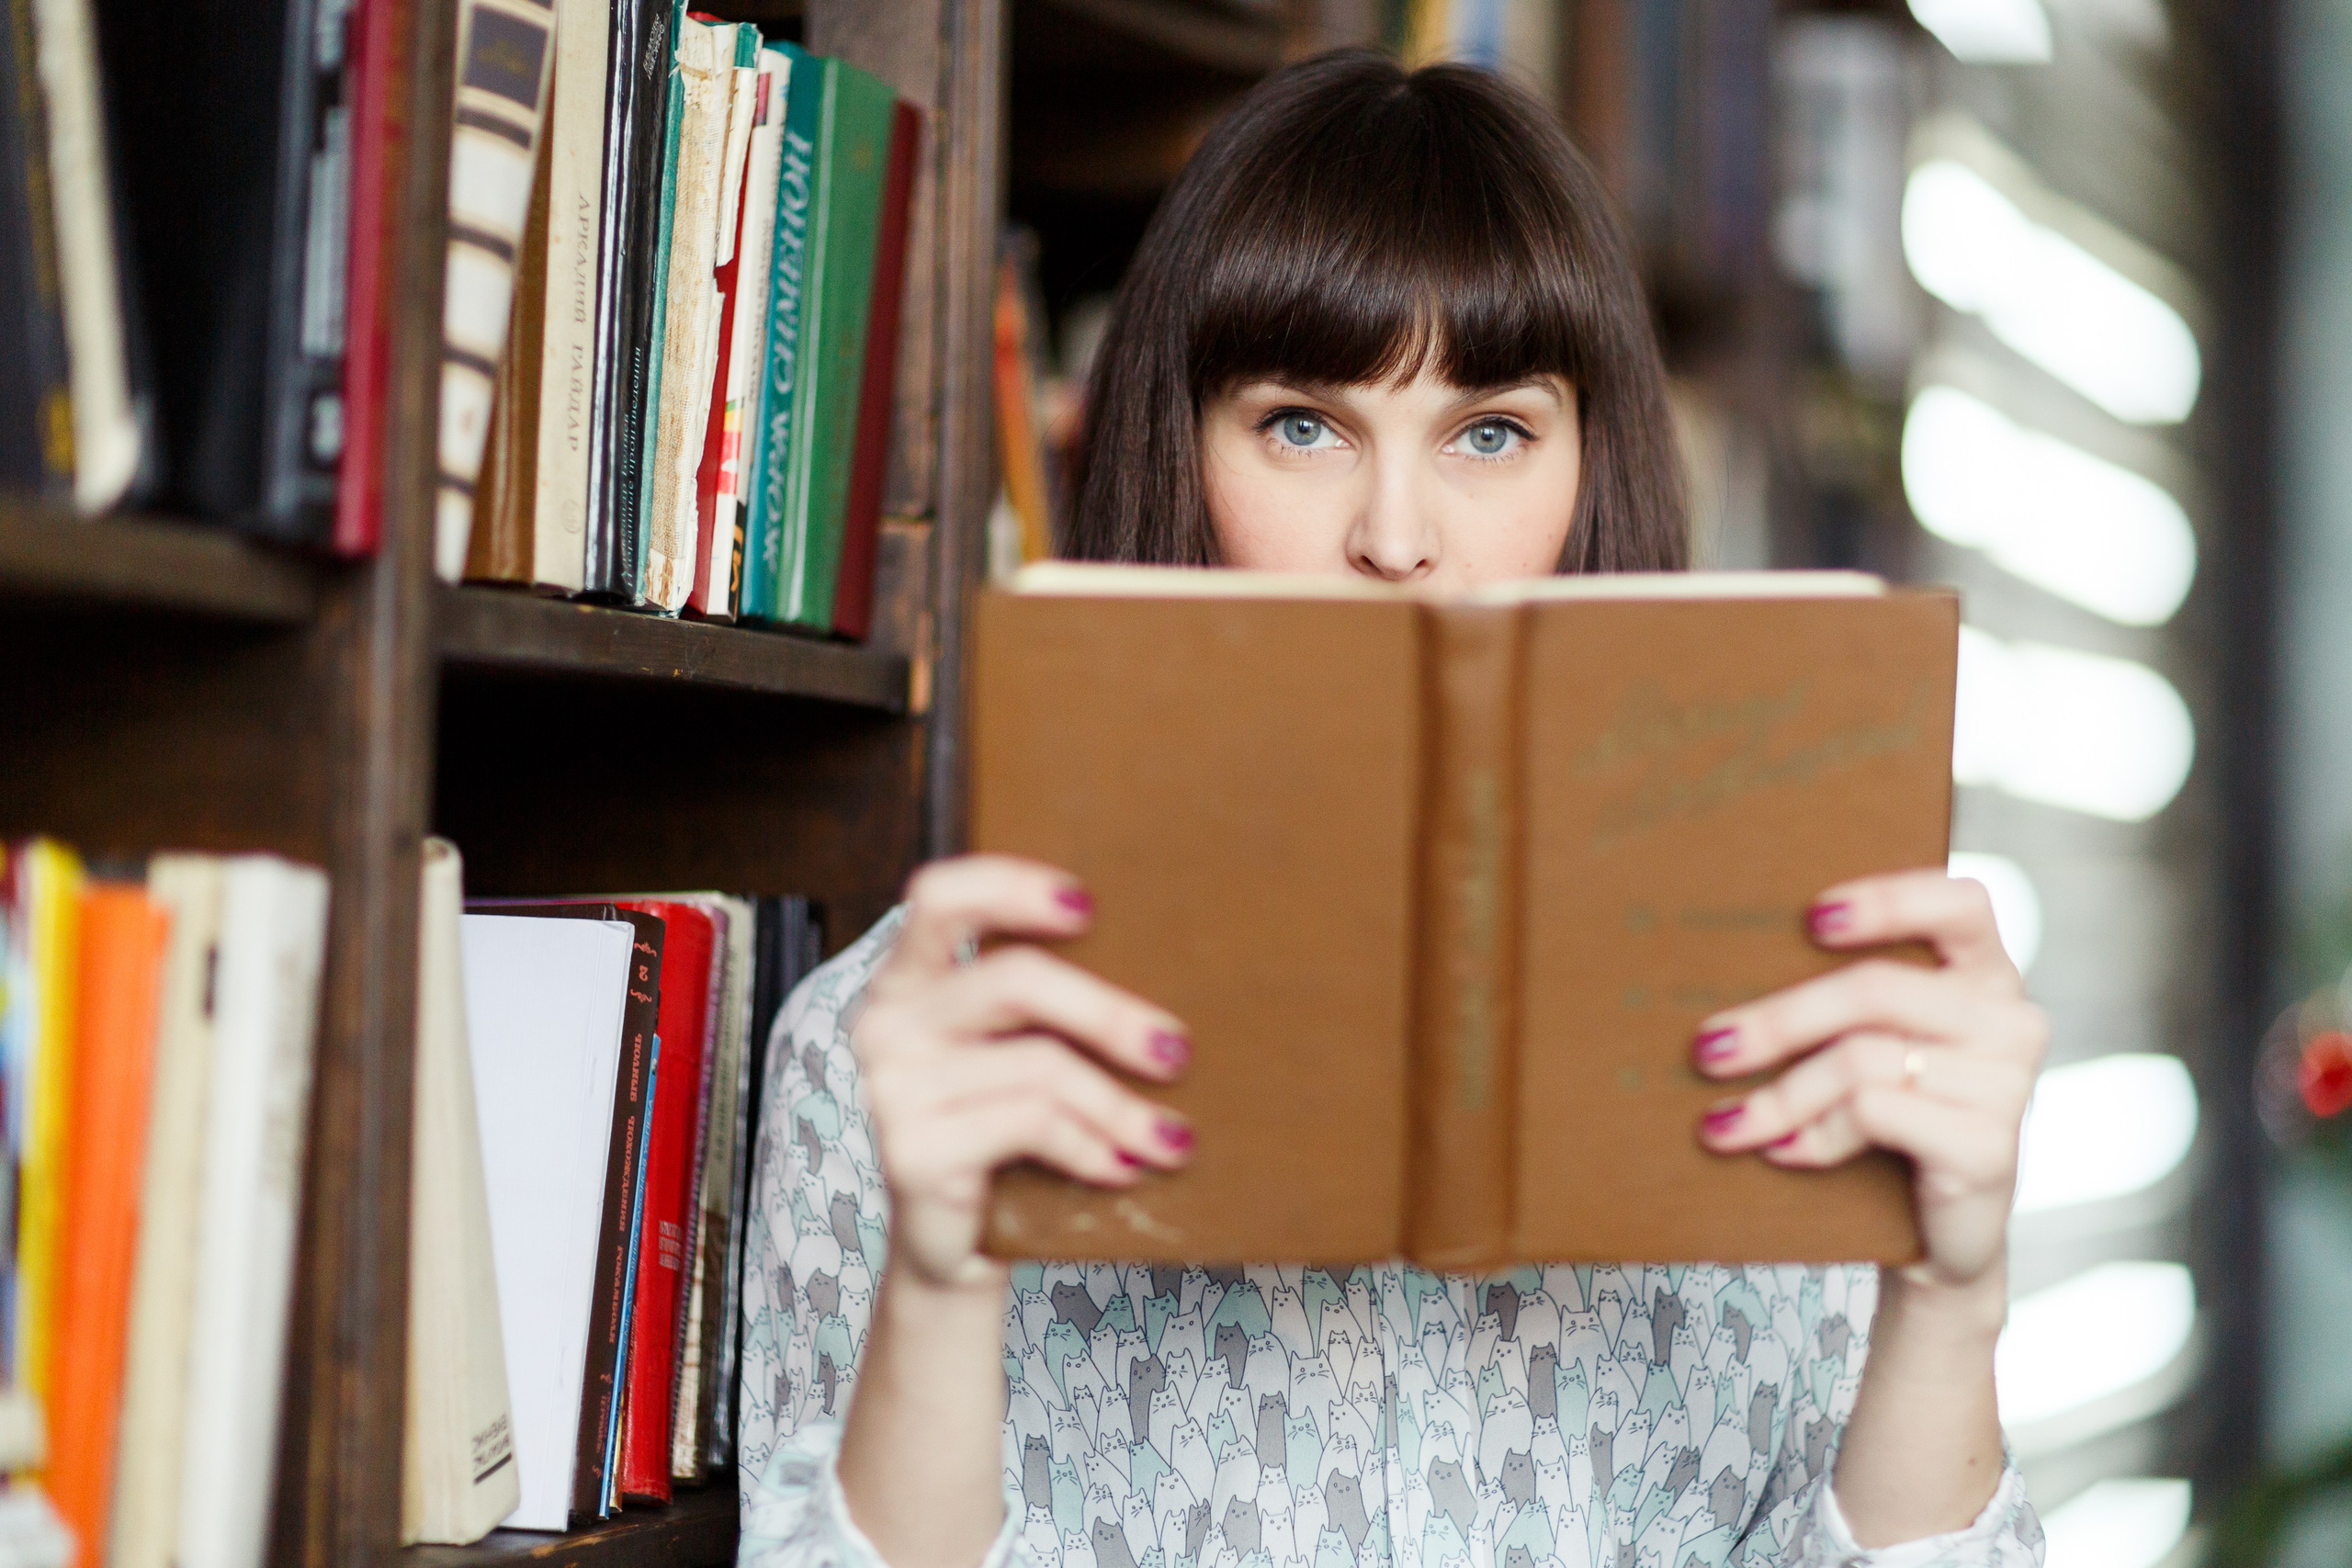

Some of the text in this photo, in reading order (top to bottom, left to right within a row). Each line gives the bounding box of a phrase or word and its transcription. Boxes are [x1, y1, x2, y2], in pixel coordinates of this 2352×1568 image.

[567, 191, 591, 451] АРКАДИЙ ГАЙДАР
[772, 130, 812, 394] СИМЕНОН
[629, 346, 641, 474] произведения
[763, 411, 790, 574] ЖОРЖ
[639, 964, 648, 981] 2
[608, 1033, 642, 1343] ПОЛНЫЕ ПОХОЖДЕНИЯ РОКАМБОЛЯ
